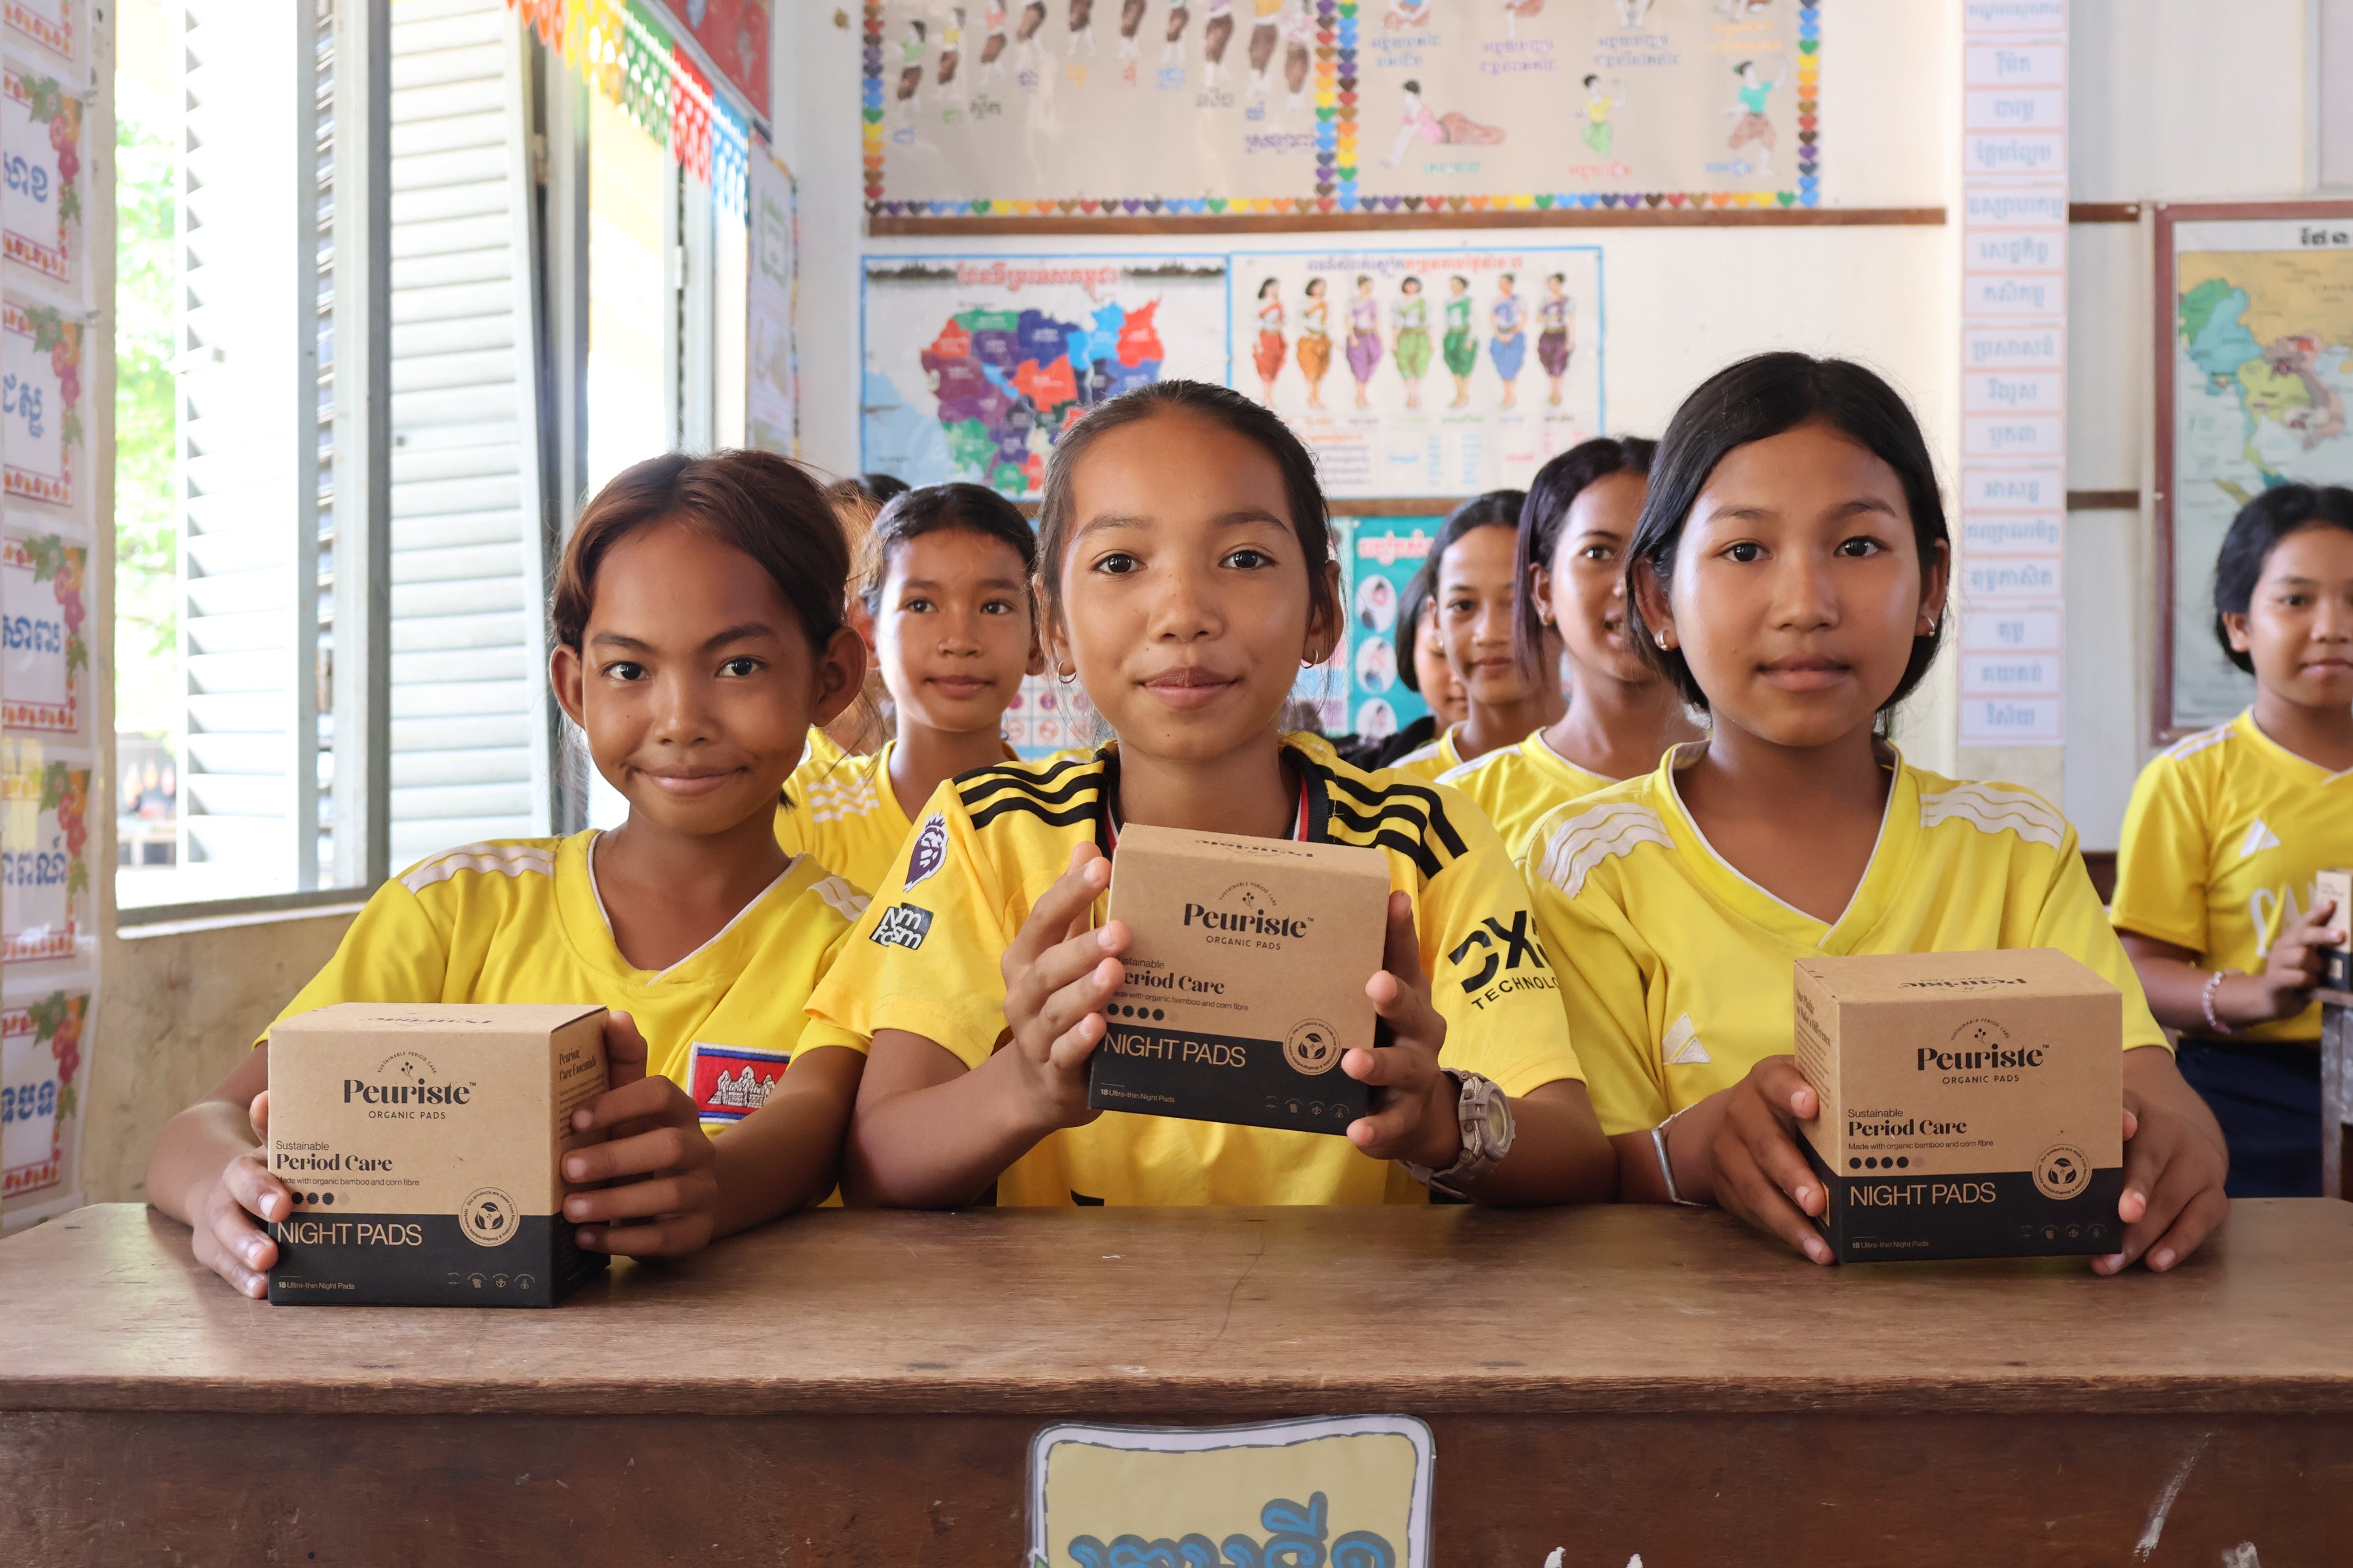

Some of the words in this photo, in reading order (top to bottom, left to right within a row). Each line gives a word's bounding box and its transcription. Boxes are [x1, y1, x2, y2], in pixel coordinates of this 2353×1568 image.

[1219, 882, 1248, 900] SUSTAINABLE
[1251, 882, 1268, 893] PERIOD
[1268, 894, 1277, 906] CARE
[1206, 935, 1251, 947] ORGANIC
[1256, 940, 1281, 951] PADS
[1120, 958, 1165, 969] ustainable
[1124, 970, 1174, 989] eriod
[1178, 975, 1225, 994] Care
[1146, 994, 1171, 1003] organic
[1172, 997, 1201, 1006] bamboo
[1233, 1003, 1249, 1011] fibre
[1104, 1032, 1180, 1060] NIGHT
[1182, 1041, 1247, 1068] PADS
[377, 1051, 406, 1073] SUSTAINABLE
[408, 1051, 427, 1061] PERIOD
[427, 1061, 437, 1074] CARE
[560, 1068, 572, 1081] Care
[1943, 1076, 1989, 1084] ORGANIC
[1109, 1090, 1139, 1099] Ultra-thin
[1140, 1092, 1158, 1102] Night
[1159, 1095, 1175, 1103] Pads
[368, 1111, 415, 1119] ORGANIC
[1848, 1108, 1904, 1118] Sustainable
[1849, 1119, 1915, 1137] Period
[1919, 1119, 1967, 1135] Care
[276, 1141, 329, 1151] Sustainable
[1886, 1142, 1913, 1151] organic
[1915, 1141, 1944, 1149] bamboo
[277, 1153, 340, 1170] Period
[345, 1154, 393, 1172] Care
[312, 1178, 339, 1186] organic
[1850, 1184, 1927, 1206] NIGHT
[1932, 1182, 1997, 1204] PADS
[277, 1221, 352, 1244] NIGHT
[357, 1223, 422, 1246] PADS
